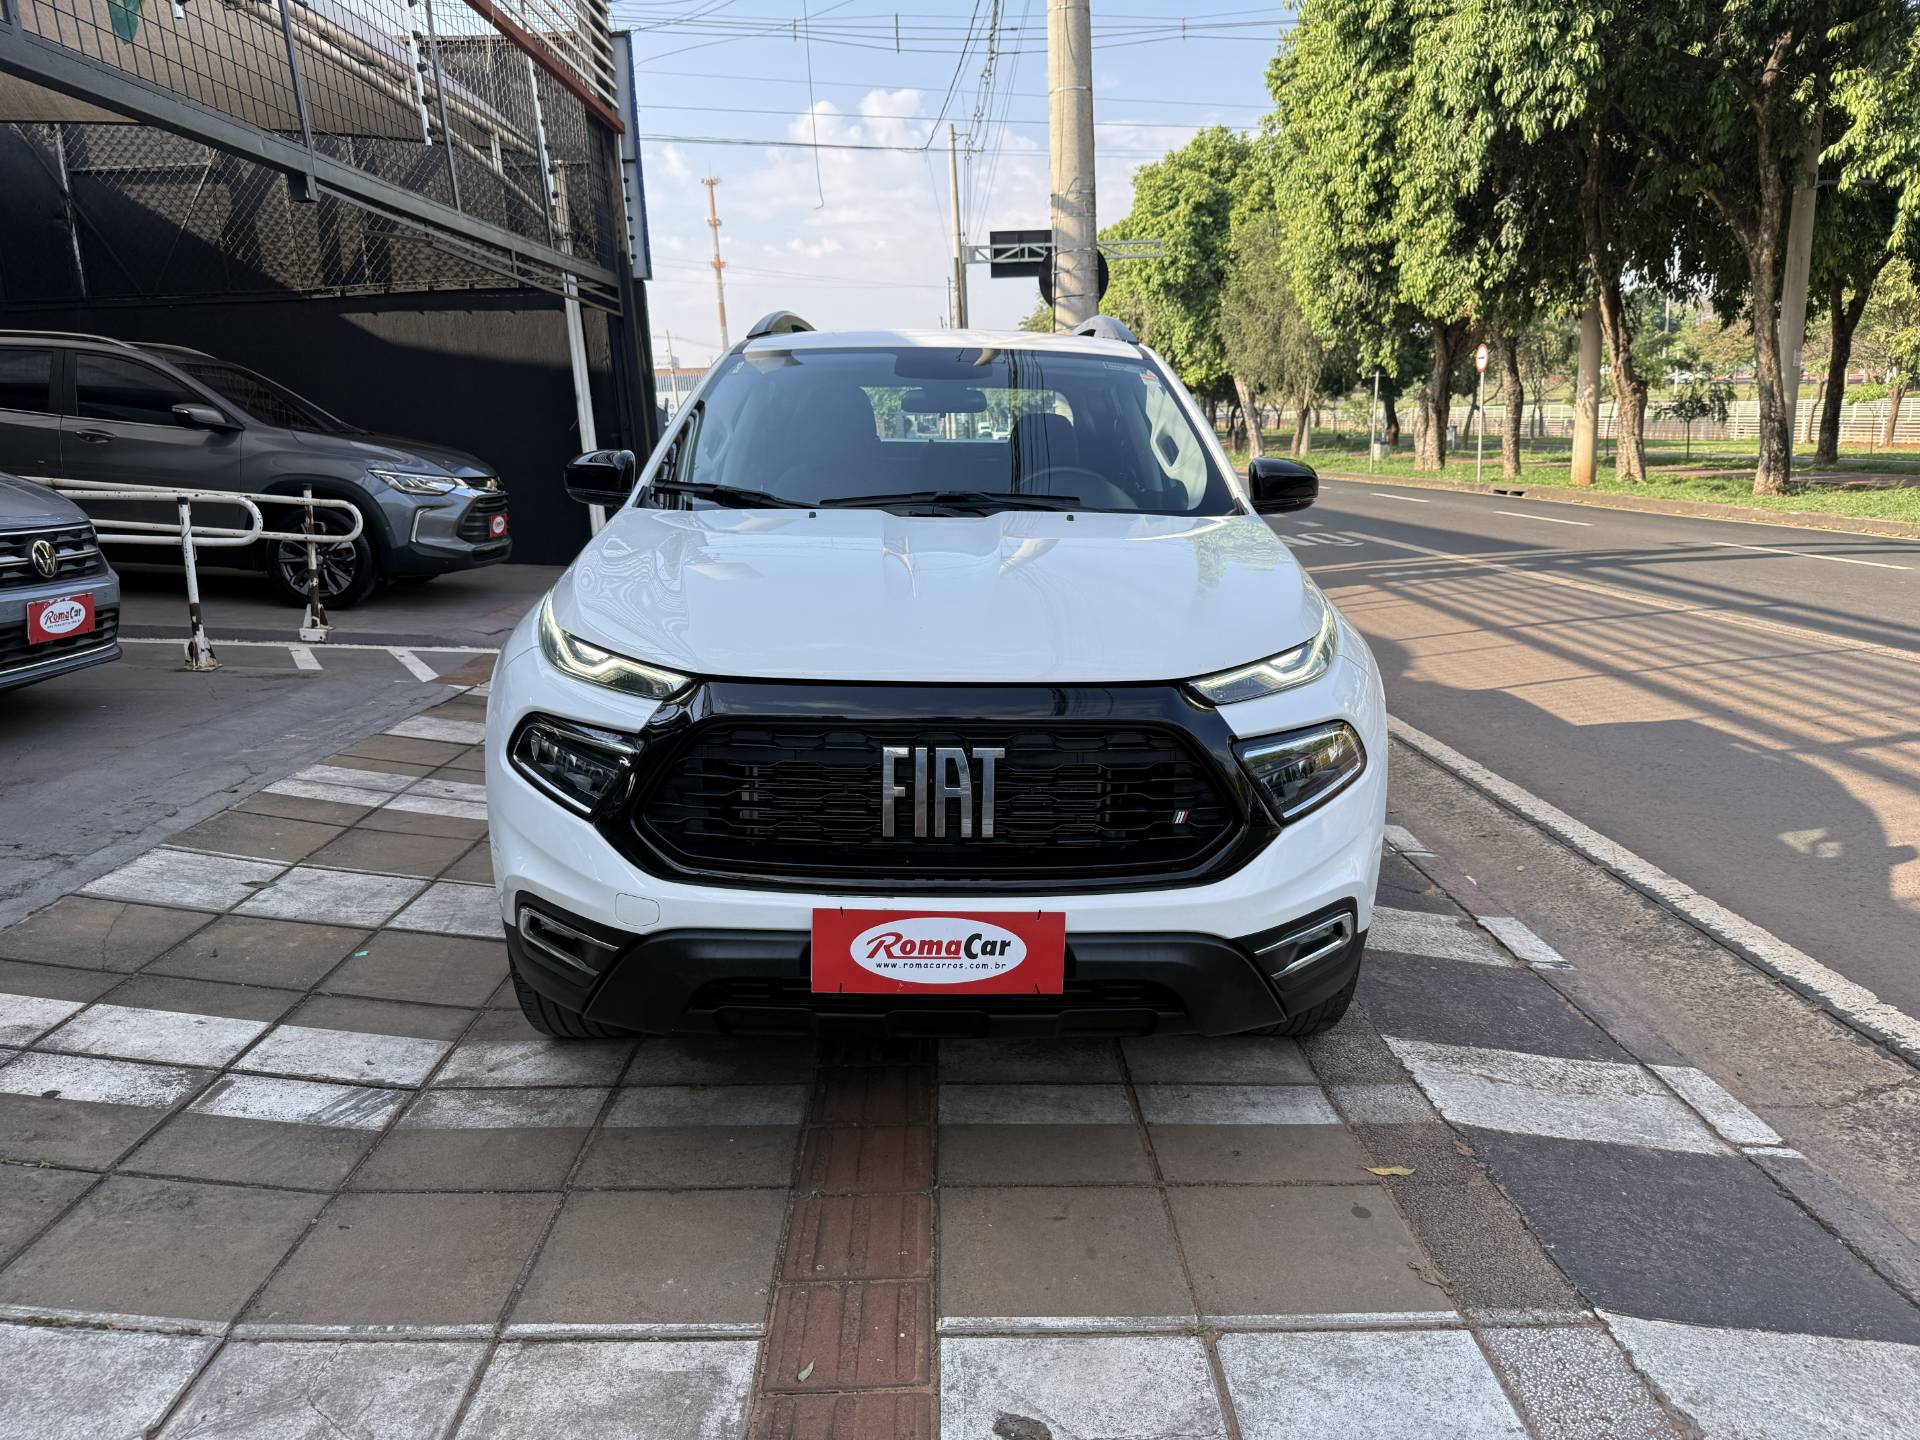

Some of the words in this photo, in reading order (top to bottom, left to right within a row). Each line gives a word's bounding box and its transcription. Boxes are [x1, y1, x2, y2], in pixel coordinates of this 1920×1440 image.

[882, 746, 1005, 838] FIAT
[866, 932, 1011, 960] RomaCar
[875, 962, 1007, 970] www.romacarros.com.br
